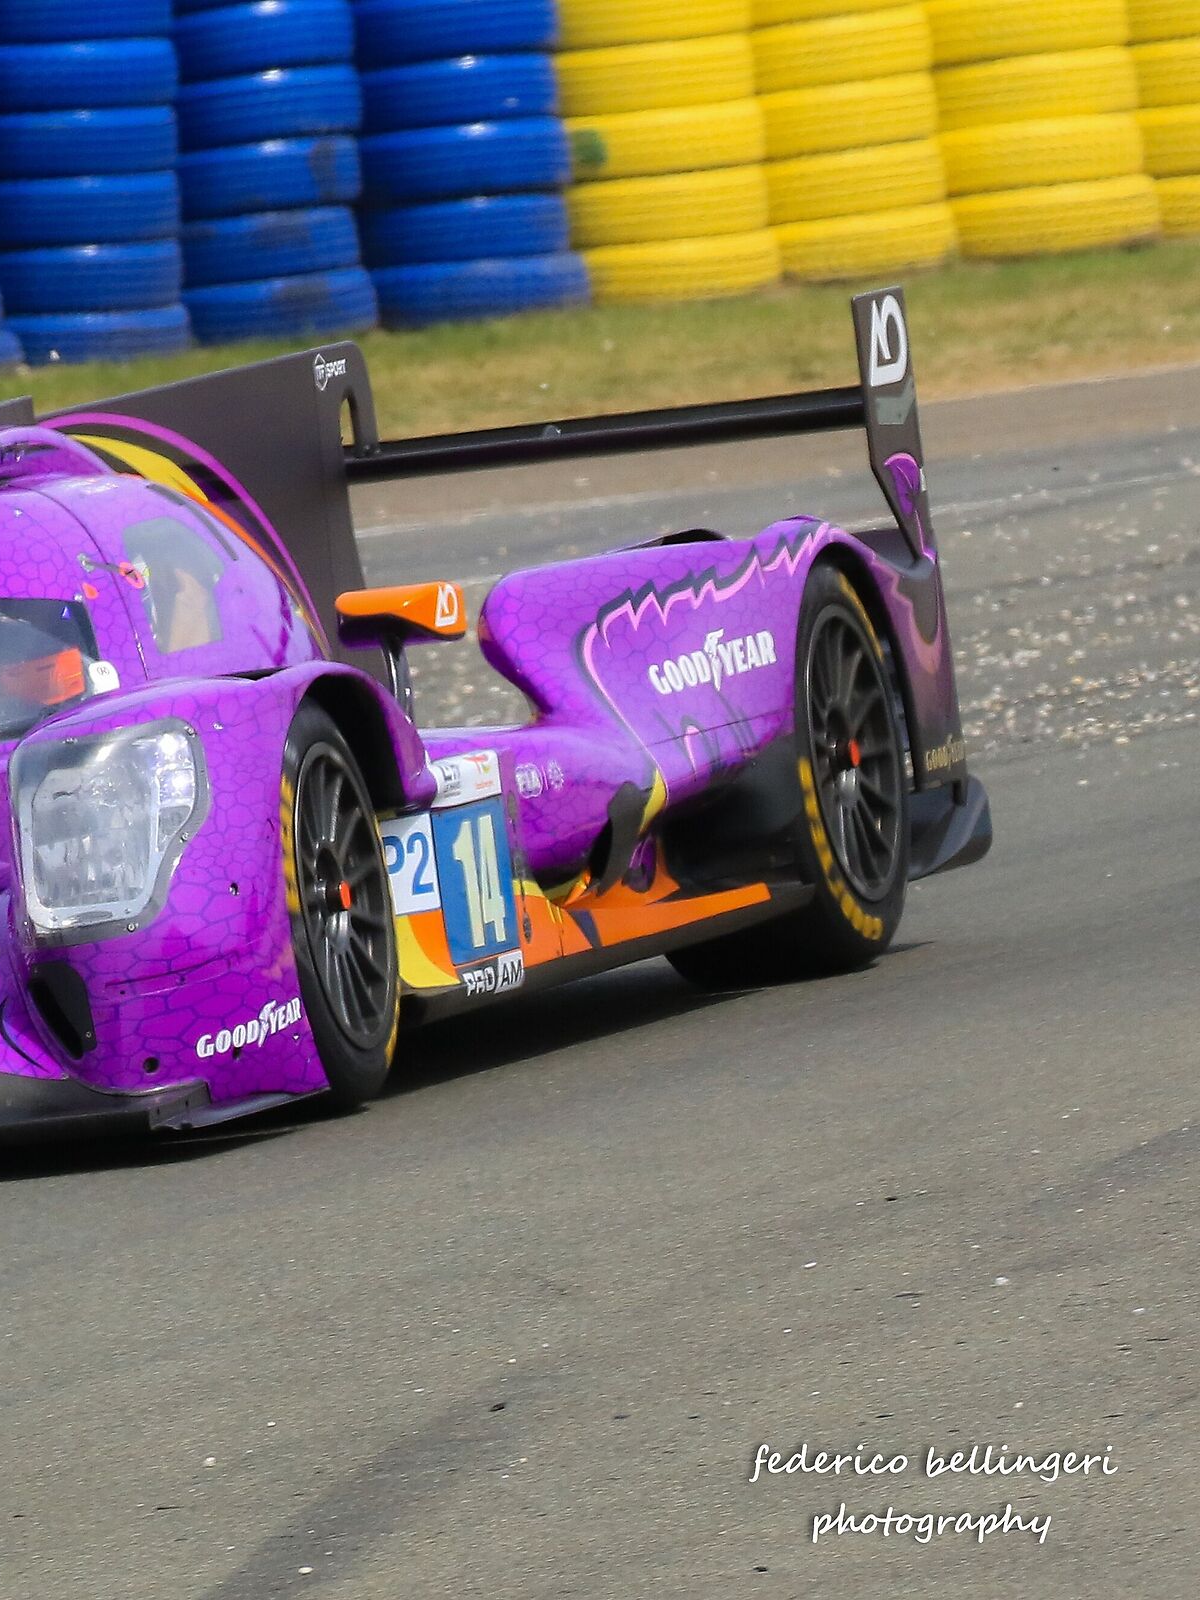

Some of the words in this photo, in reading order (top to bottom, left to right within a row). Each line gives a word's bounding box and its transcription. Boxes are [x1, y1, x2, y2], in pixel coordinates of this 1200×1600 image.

[326, 358, 346, 378] SPORT
[647, 629, 777, 695] GOODYEAR
[452, 814, 507, 948] 14
[196, 997, 302, 1058] GOODYEAR
